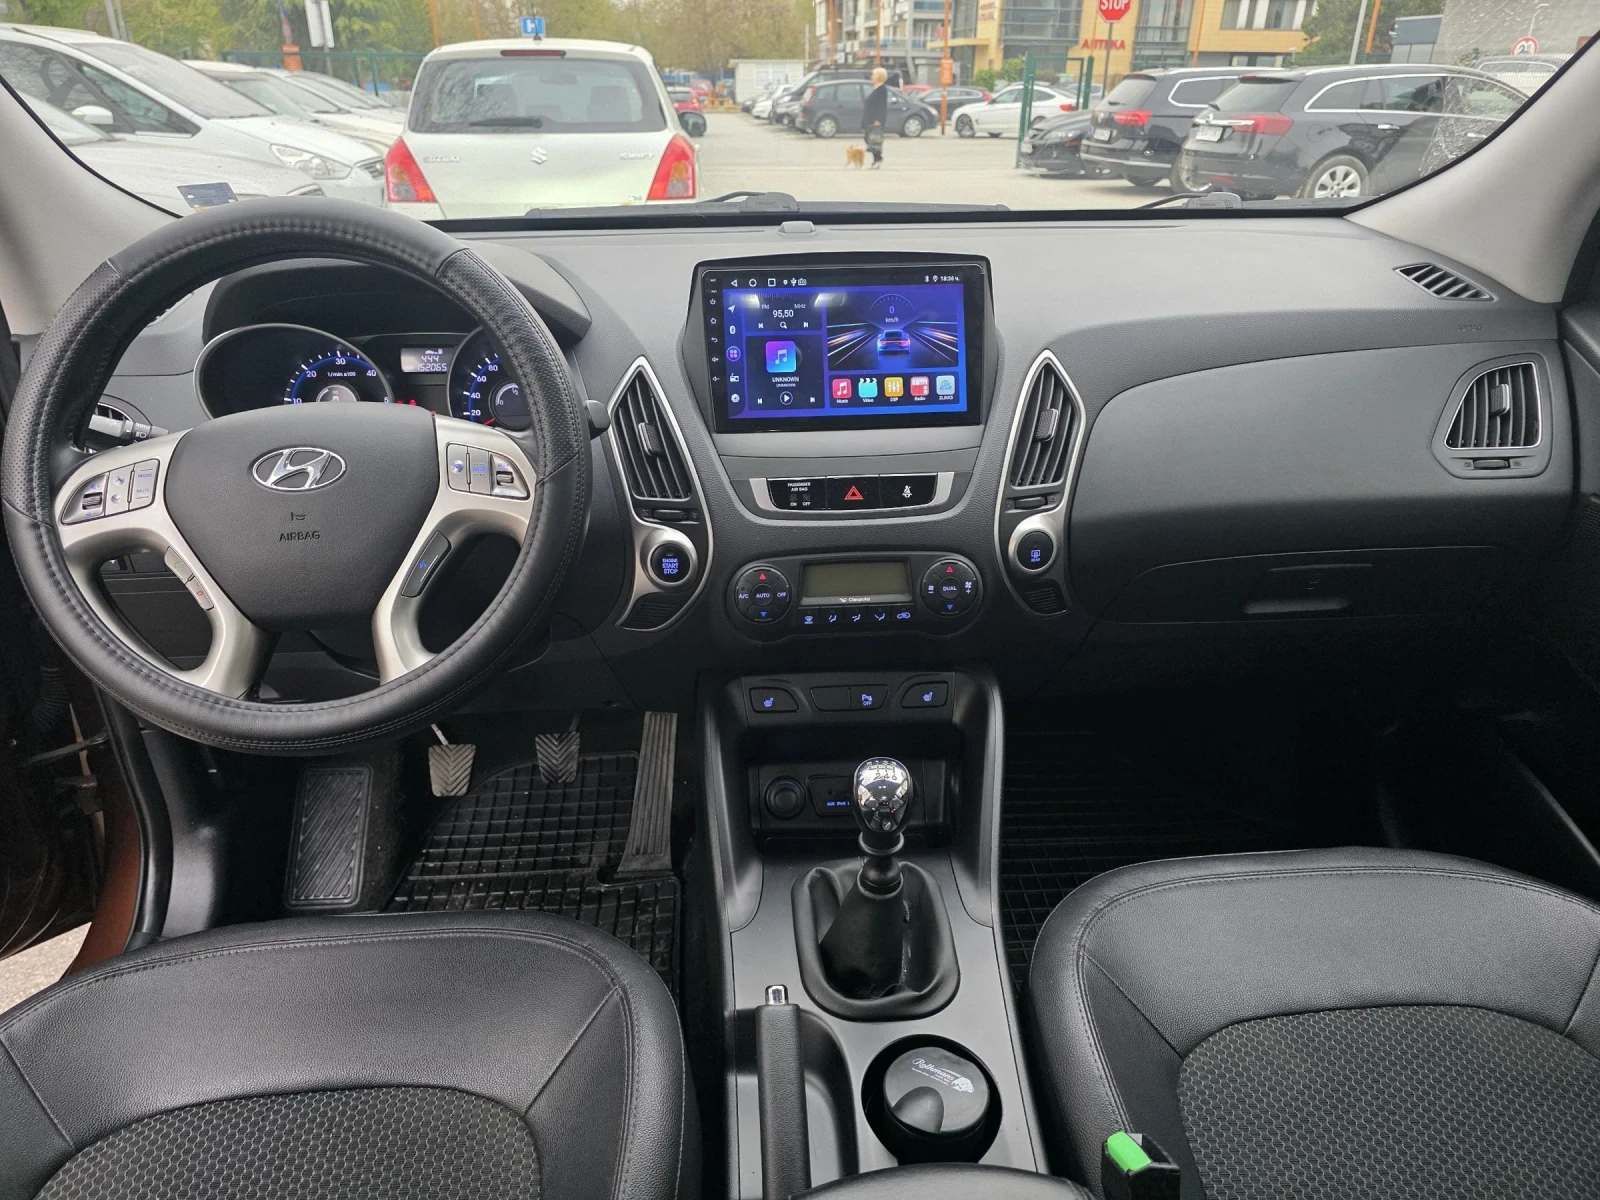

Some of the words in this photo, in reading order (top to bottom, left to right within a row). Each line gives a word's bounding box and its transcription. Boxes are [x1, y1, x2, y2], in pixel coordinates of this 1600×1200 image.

[1100, 0, 1129, 10] STOP
[335, 357, 346, 365] 30
[417, 363, 448, 372] 152065
[488, 364, 499, 372] 80
[306, 370, 317, 378] 20
[366, 369, 377, 377] 40
[279, 530, 320, 542] AIRBAG
[912, 1058, 955, 1081] Rothmans
